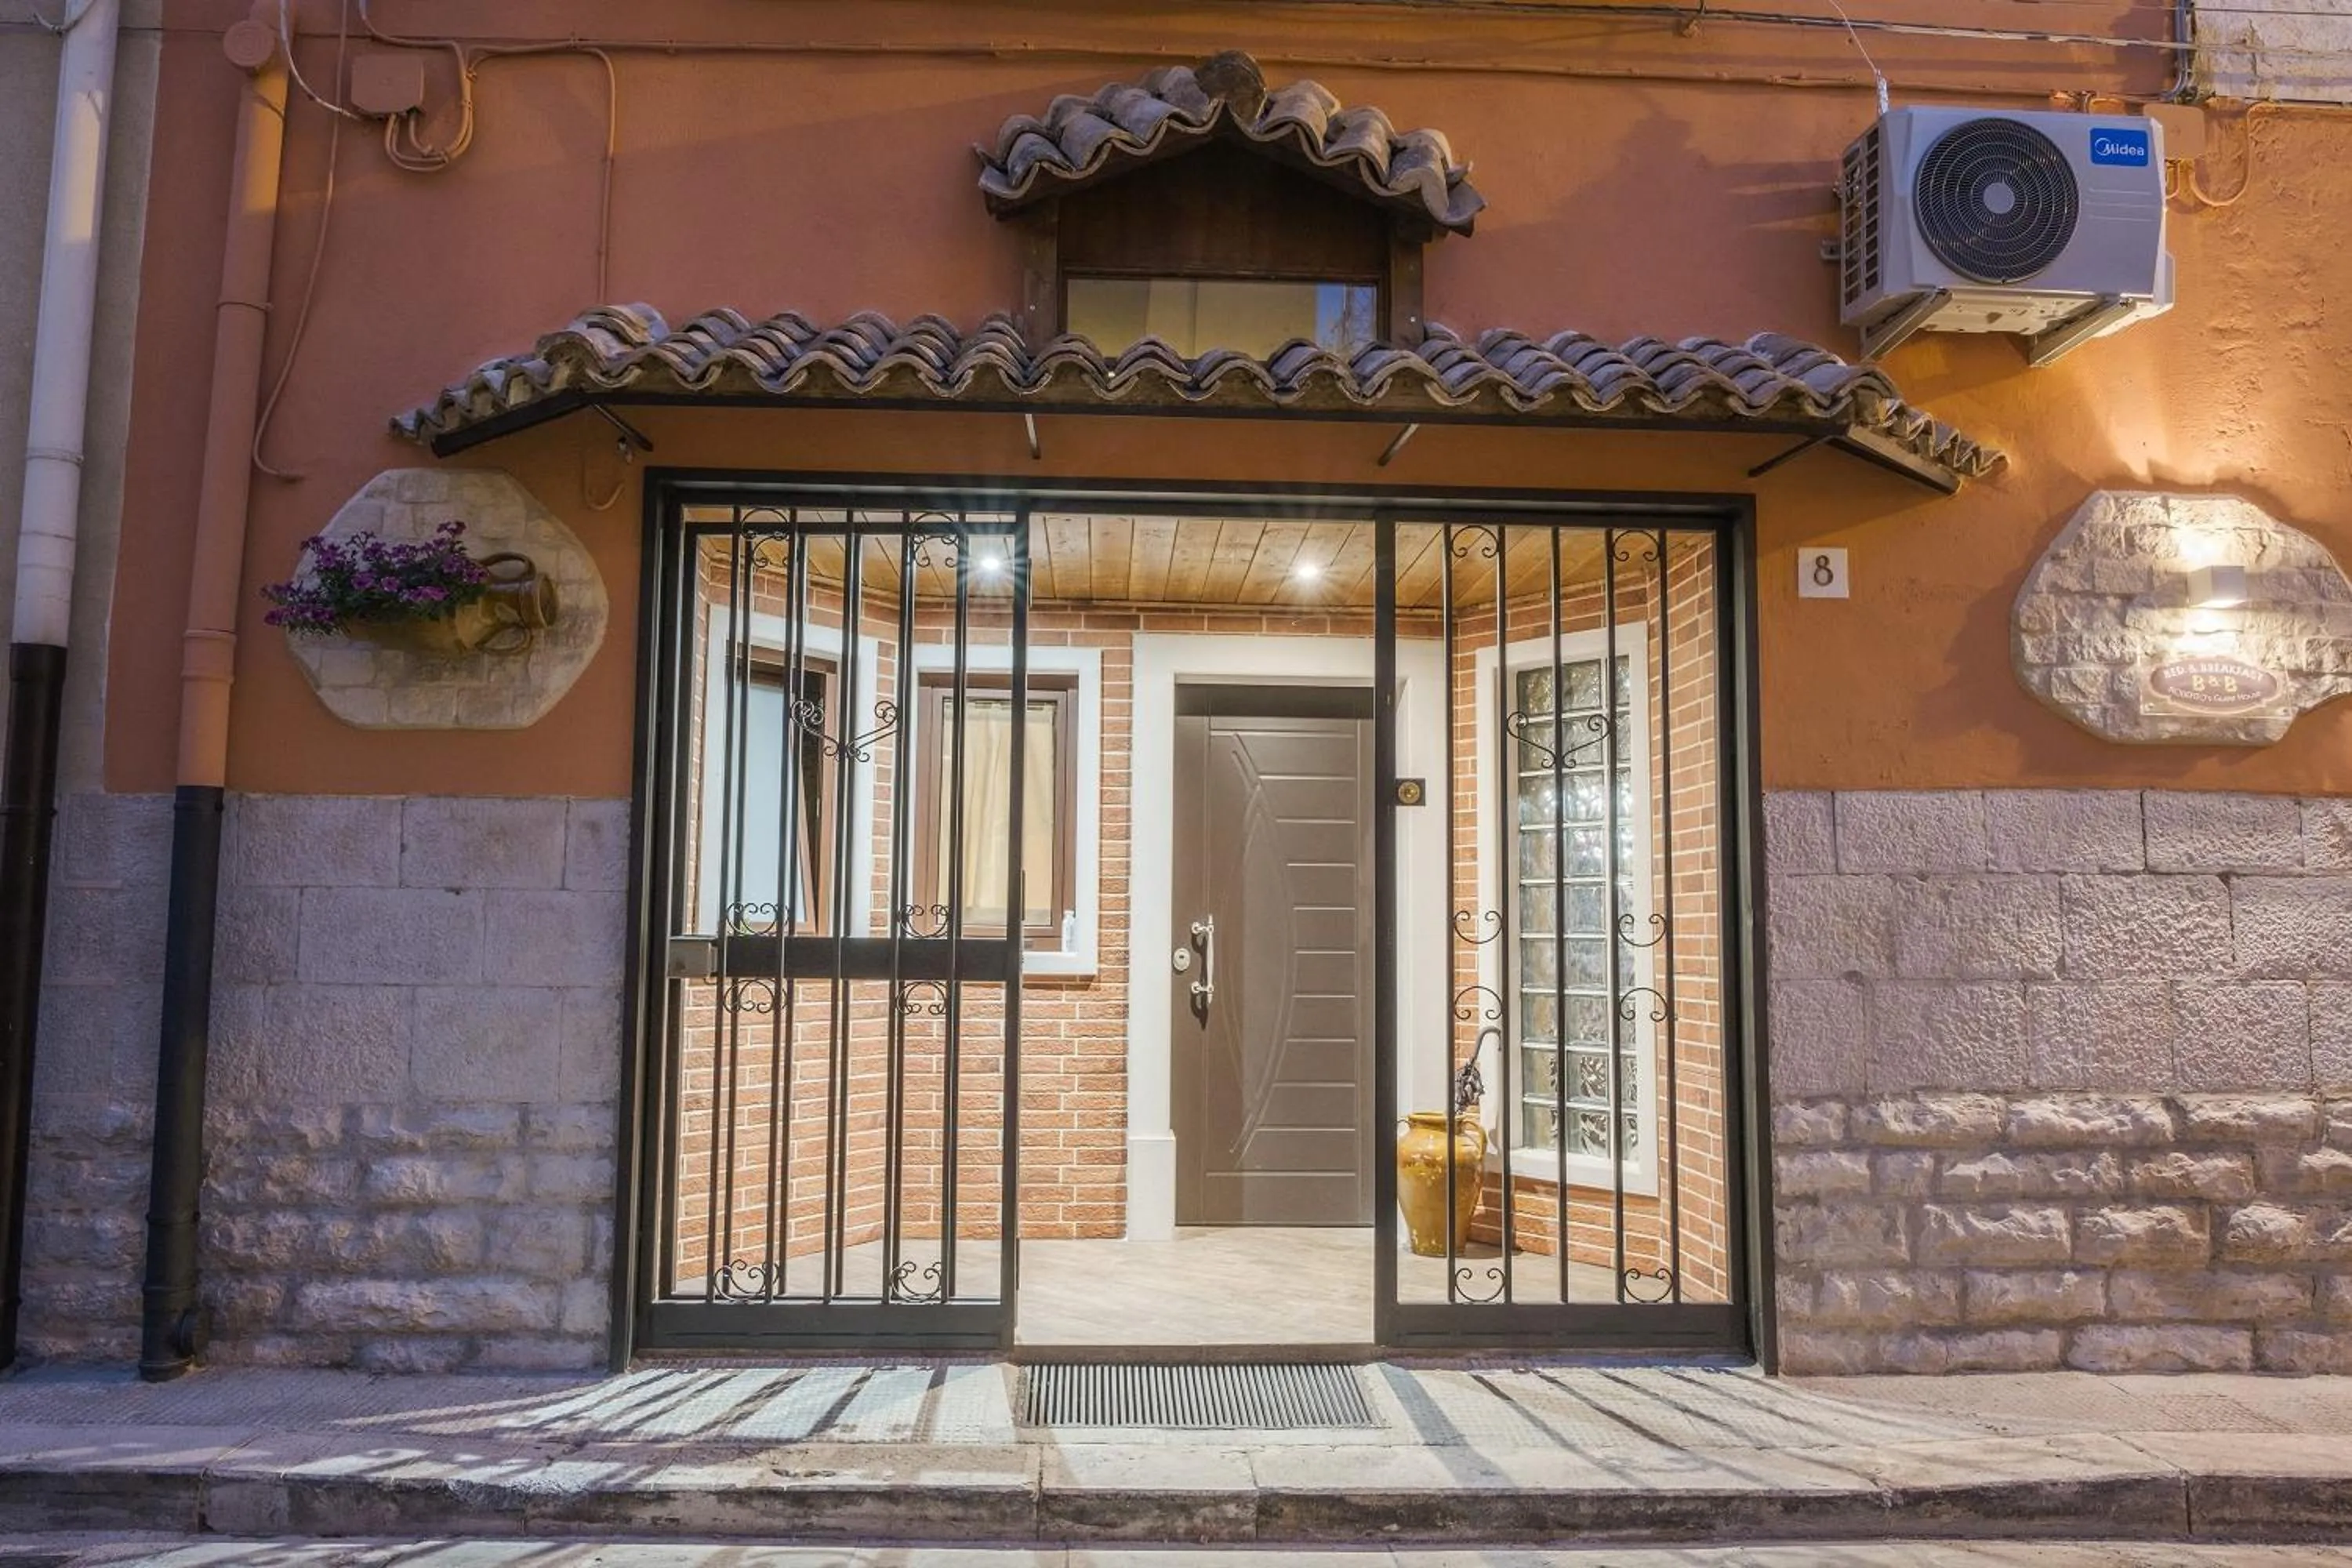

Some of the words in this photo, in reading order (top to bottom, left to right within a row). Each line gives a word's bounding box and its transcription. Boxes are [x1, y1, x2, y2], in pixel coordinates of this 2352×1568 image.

[2094, 137, 2145, 156] Midea
[1813, 554, 1834, 586] 8
[2201, 662, 2264, 682] BREAKFAST
